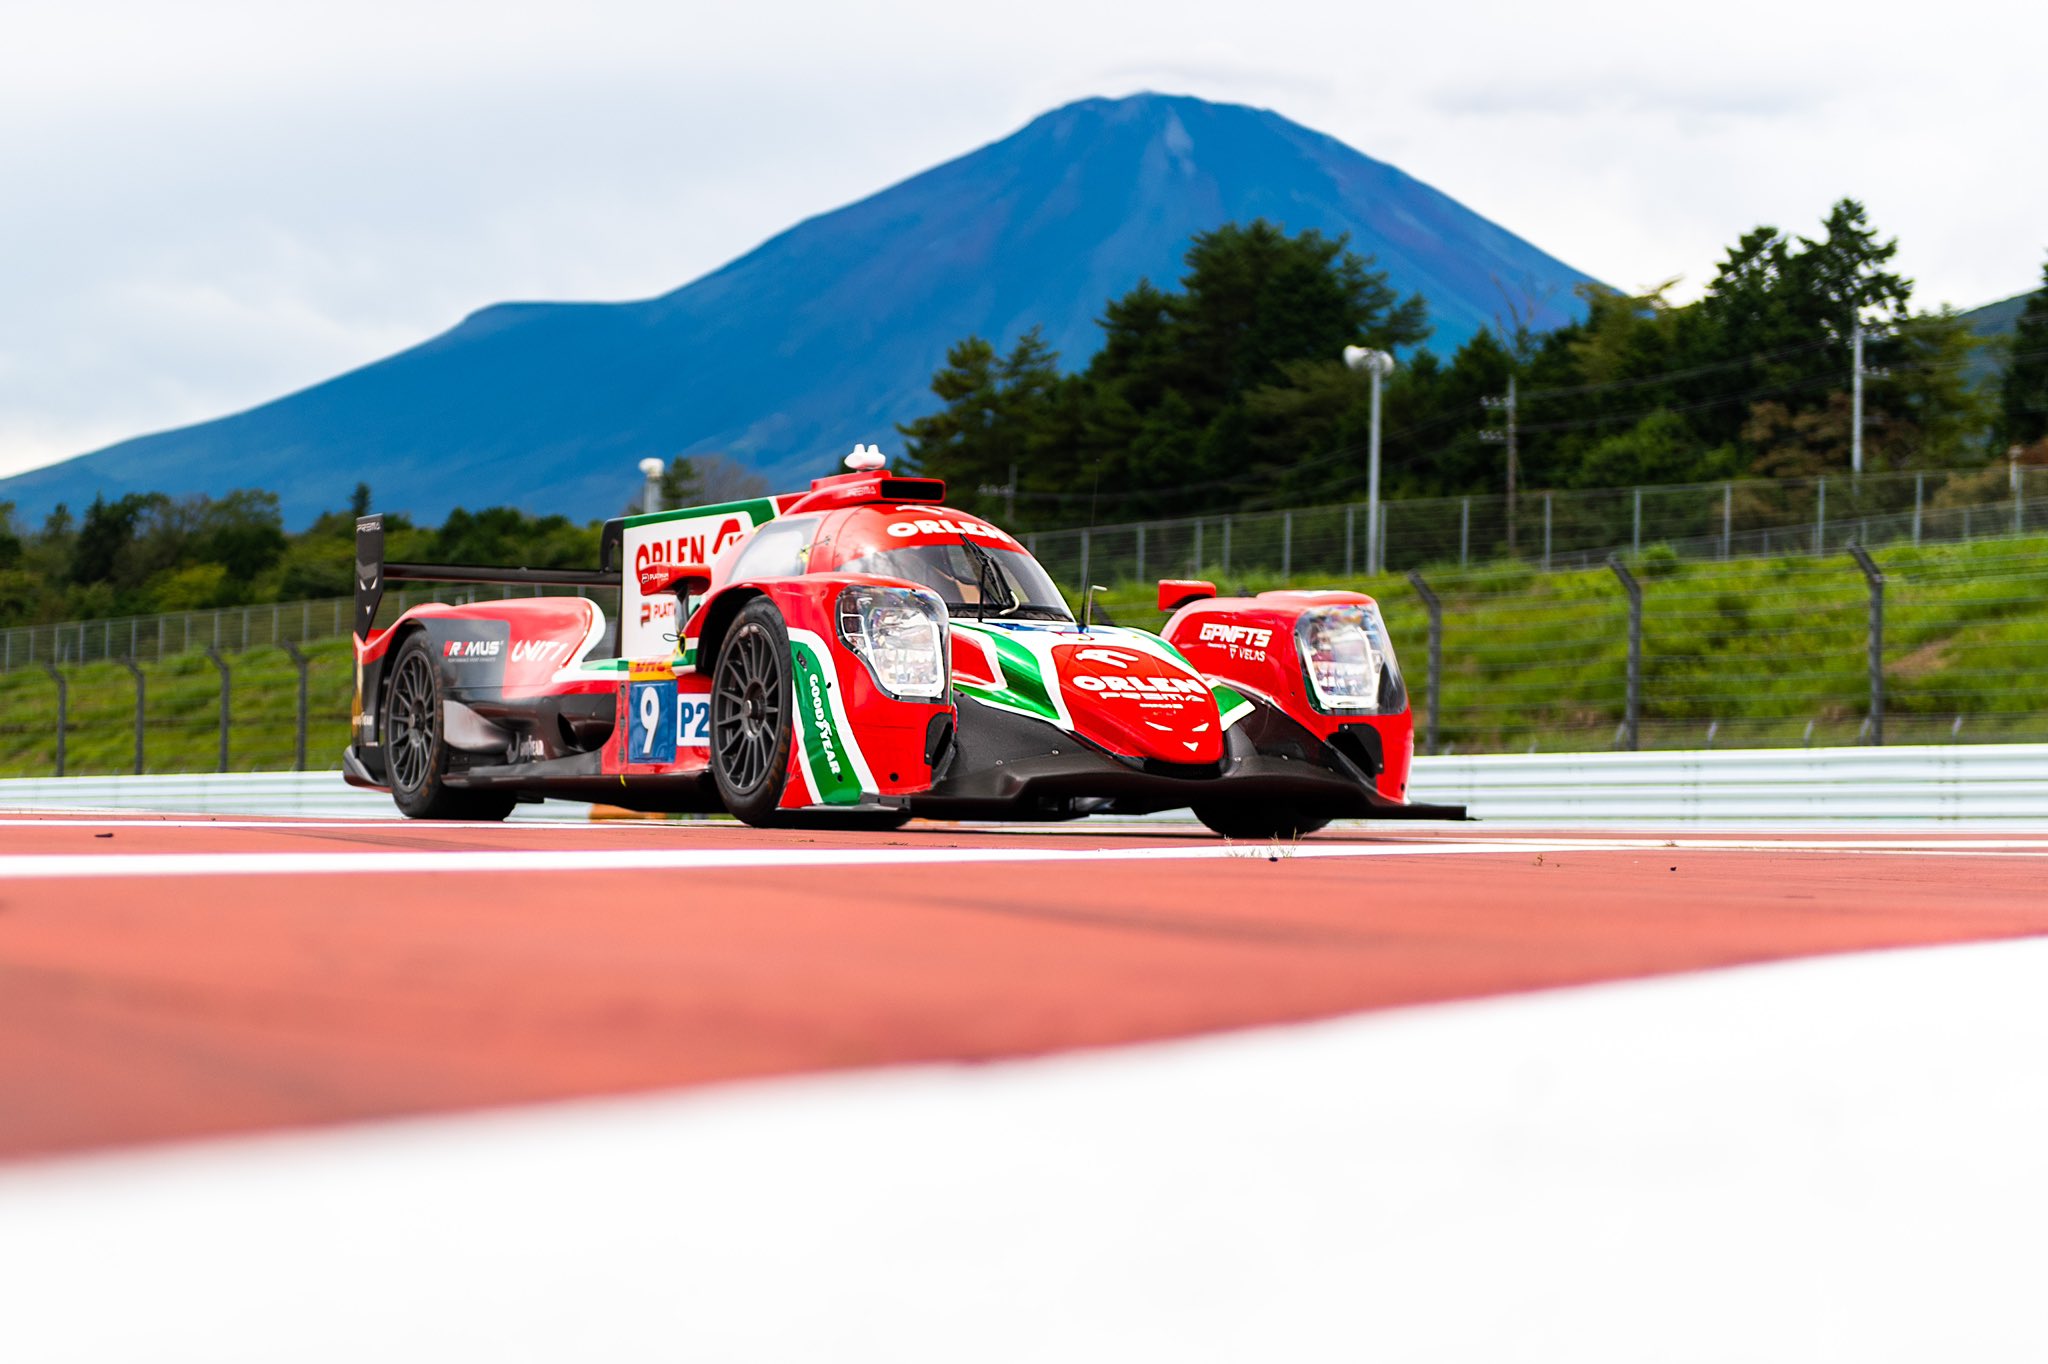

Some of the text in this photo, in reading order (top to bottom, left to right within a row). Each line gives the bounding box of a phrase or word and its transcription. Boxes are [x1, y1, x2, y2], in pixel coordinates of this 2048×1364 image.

[887, 520, 1012, 544] ORLEN
[1199, 622, 1273, 649] GPNFTS
[447, 640, 500, 657] REMUS
[1239, 647, 1266, 663] VELAS
[1072, 675, 1209, 695] ORLEN
[640, 686, 660, 755] 9
[680, 701, 711, 738] P2
[809, 673, 841, 775] GOODYEAR
